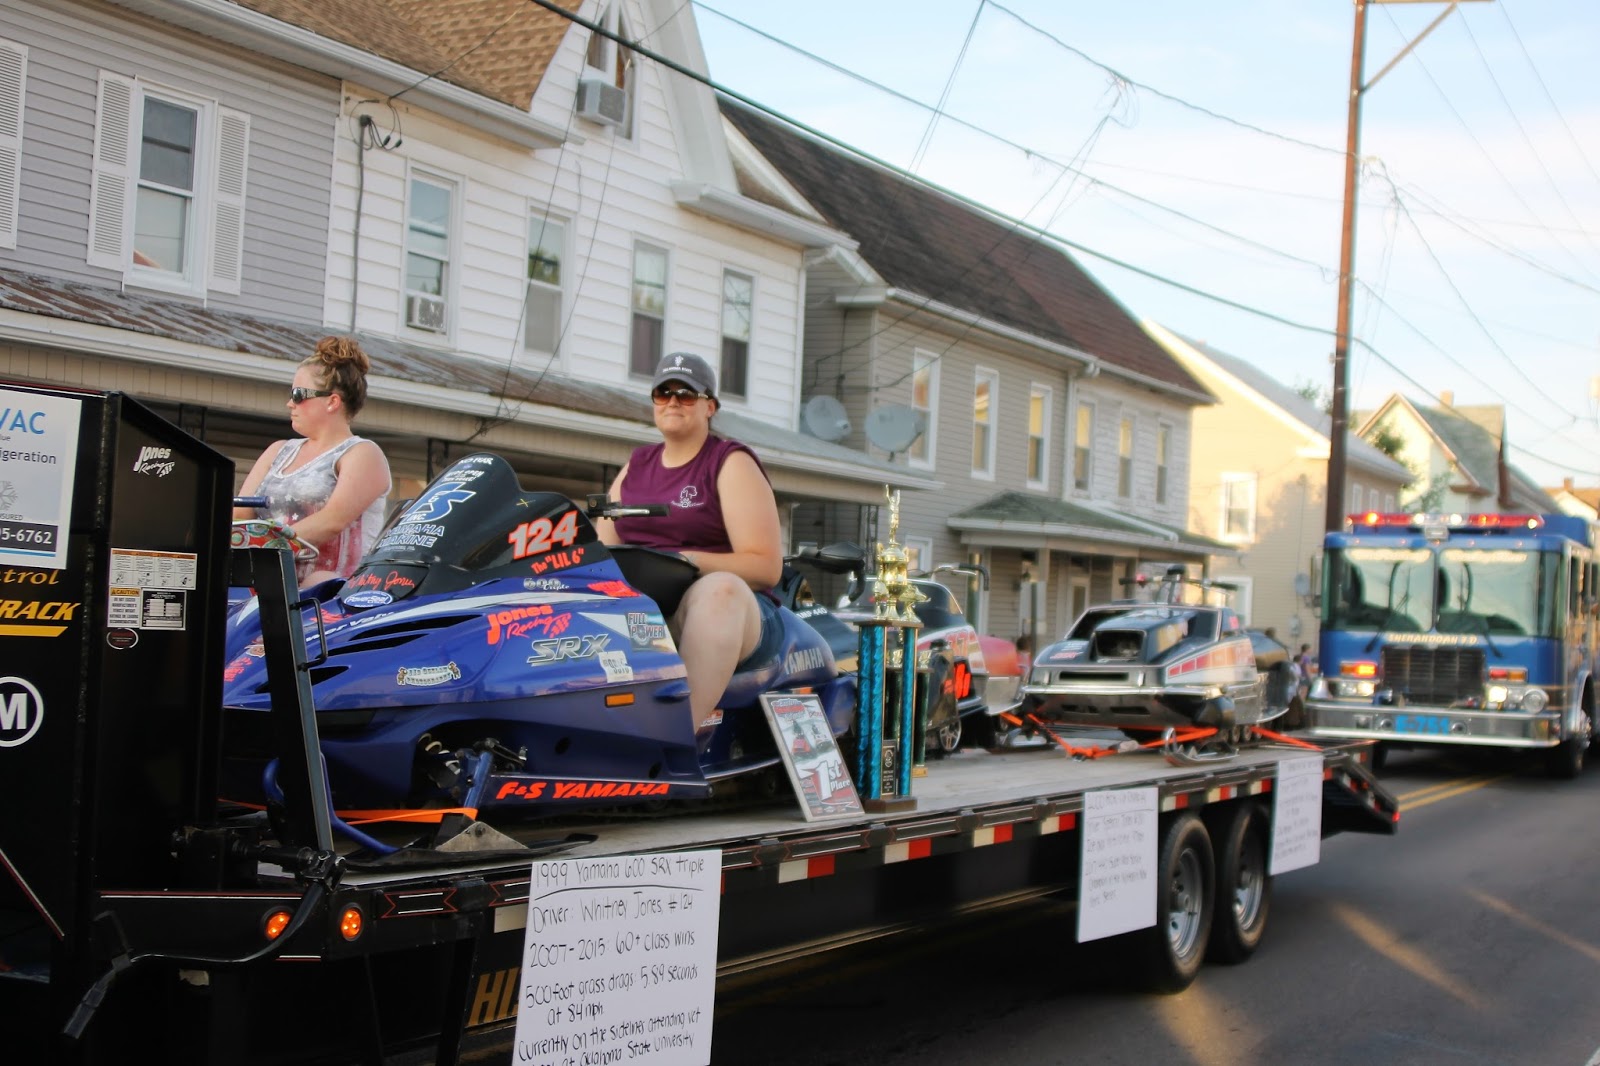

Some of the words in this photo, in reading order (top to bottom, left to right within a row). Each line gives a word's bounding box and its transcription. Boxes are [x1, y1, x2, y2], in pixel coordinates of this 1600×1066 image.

[133, 446, 171, 472] Jones
[138, 461, 166, 476] Racing
[0, 527, 52, 544] 5-6762
[508, 510, 579, 560] 124
[531, 560, 547, 574] The
[545, 552, 571, 570] "LIL
[572, 548, 585, 564] 6"
[0, 568, 59, 585] trol
[523, 578, 562, 590] 600
[0, 600, 81, 620] RACK
[628, 613, 646, 625] FULL
[487, 605, 553, 645] Jones
[507, 615, 555, 639] Racing
[630, 625, 664, 638] POWER
[527, 634, 611, 666] SRX
[783, 647, 825, 675] YAMAHA
[0, 693, 27, 730] M
[496, 781, 547, 799] F&S
[552, 782, 670, 799] YAMAHA
[815, 760, 842, 801] 1st
[830, 779, 850, 791] Place
[535, 862, 568, 888] 1999
[576, 861, 620, 884] Yamaha
[624, 858, 645, 878] 600
[651, 857, 672, 876] SRX
[676, 855, 704, 879] triple
[532, 904, 574, 933] Driver:
[580, 900, 628, 923] Whitney
[615, 931, 641, 955] 60+
[644, 931, 671, 951] class
[674, 930, 695, 946] wins
[578, 977, 605, 1001] grass
[667, 963, 698, 982] seconds
[468, 967, 520, 1026] HI
[547, 1008, 562, 1026] at
[568, 1003, 583, 1023] 84
[584, 1002, 604, 1021] mph
[518, 1034, 569, 1062] Currently
[572, 1032, 588, 1050] on
[589, 1027, 607, 1043] the
[609, 1018, 646, 1040] sidelines
[648, 1011, 685, 1033] attending
[687, 1009, 701, 1024] vet
[579, 1047, 622, 1066] Oklahoma
[627, 1040, 651, 1059] State
[654, 1034, 694, 1053] University
